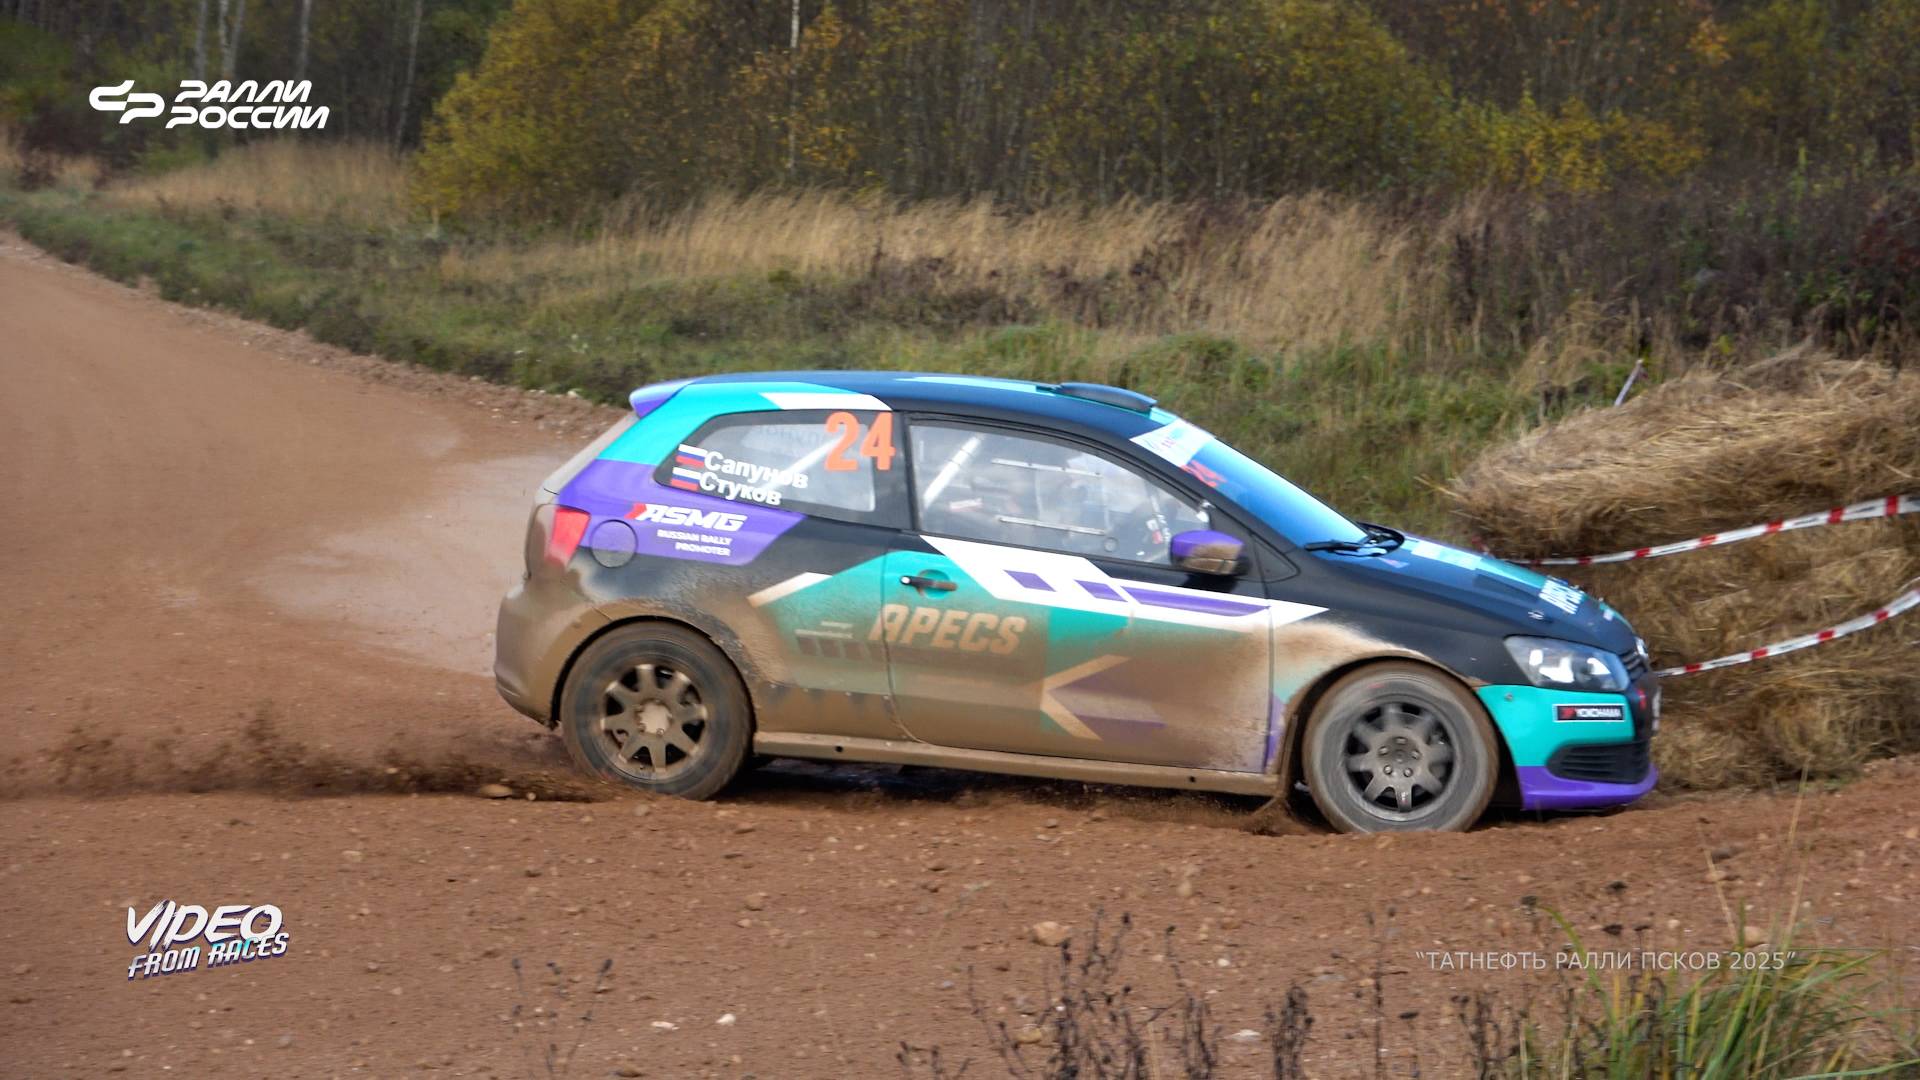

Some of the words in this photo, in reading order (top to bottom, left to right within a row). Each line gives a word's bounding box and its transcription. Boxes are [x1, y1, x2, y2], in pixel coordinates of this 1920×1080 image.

[824, 411, 896, 472] 24
[699, 472, 782, 506] Стуков
[704, 451, 808, 489] Сапунов
[635, 503, 748, 532] ASMG
[868, 603, 1027, 655] APECS
